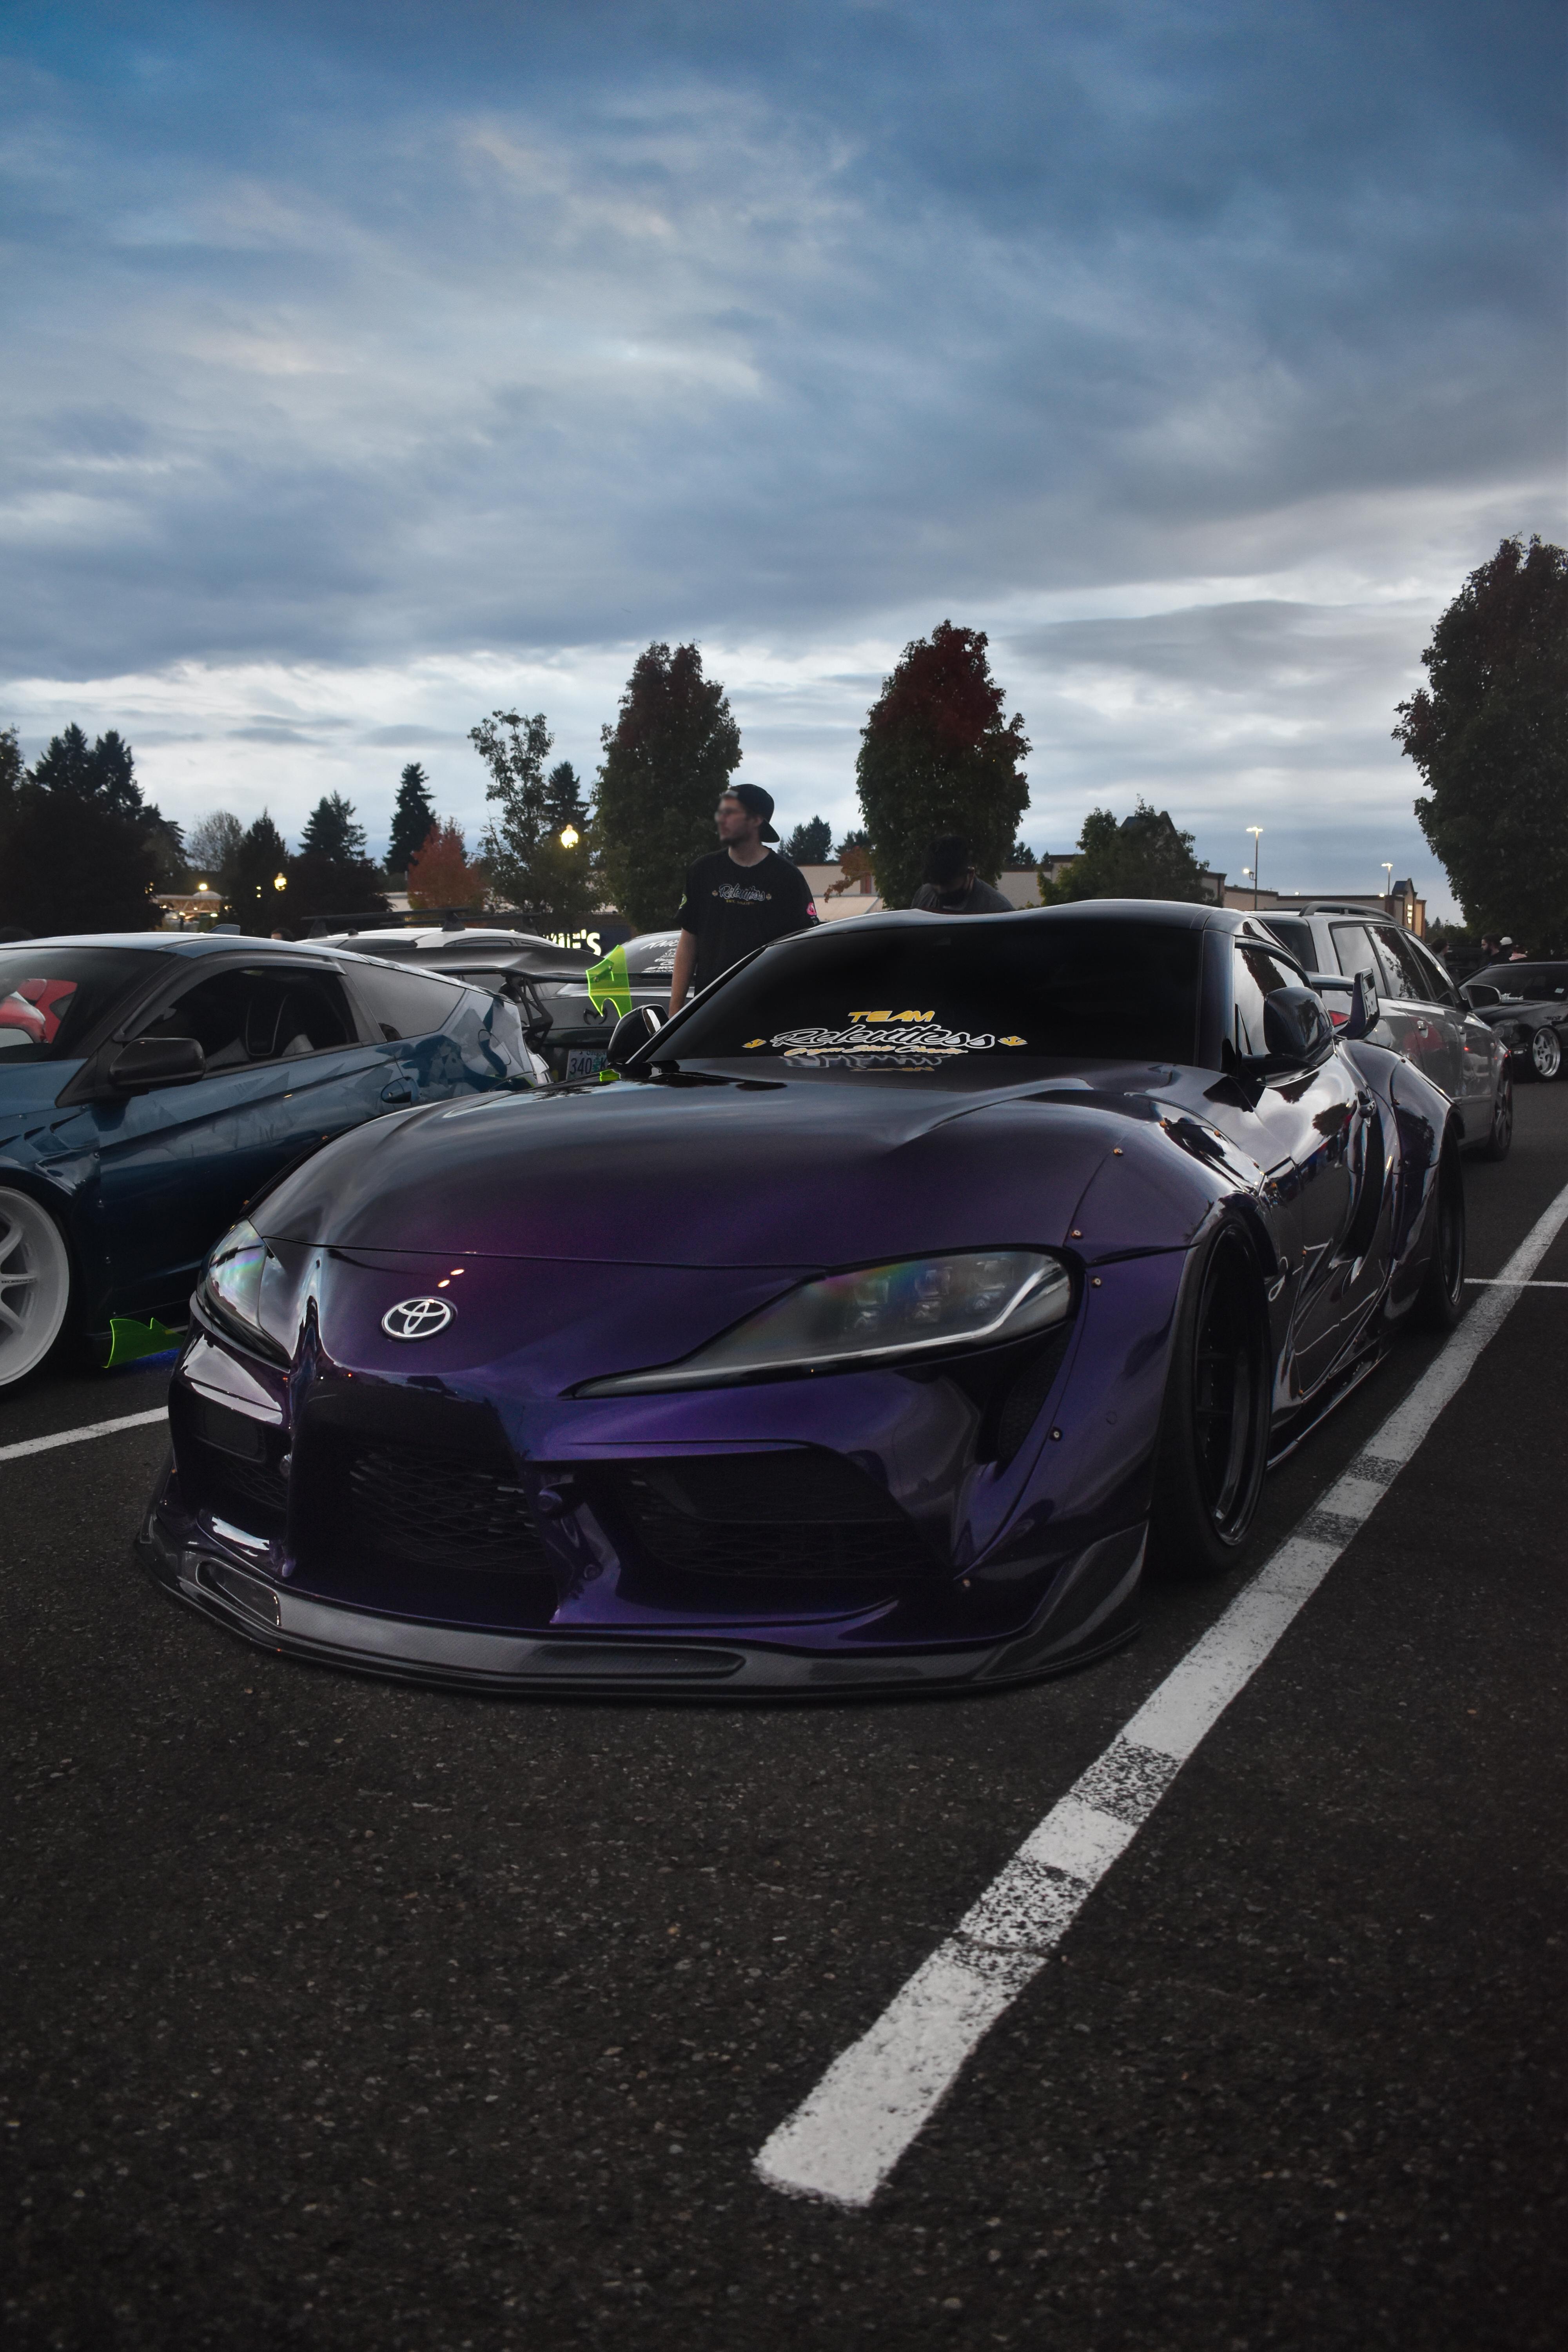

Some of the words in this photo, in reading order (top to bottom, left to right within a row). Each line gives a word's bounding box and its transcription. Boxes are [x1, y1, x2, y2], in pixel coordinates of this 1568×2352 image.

[848, 1011, 935, 1023] TEAM
[769, 1024, 995, 1049] Relentless
[570, 1058, 592, 1074] 340
